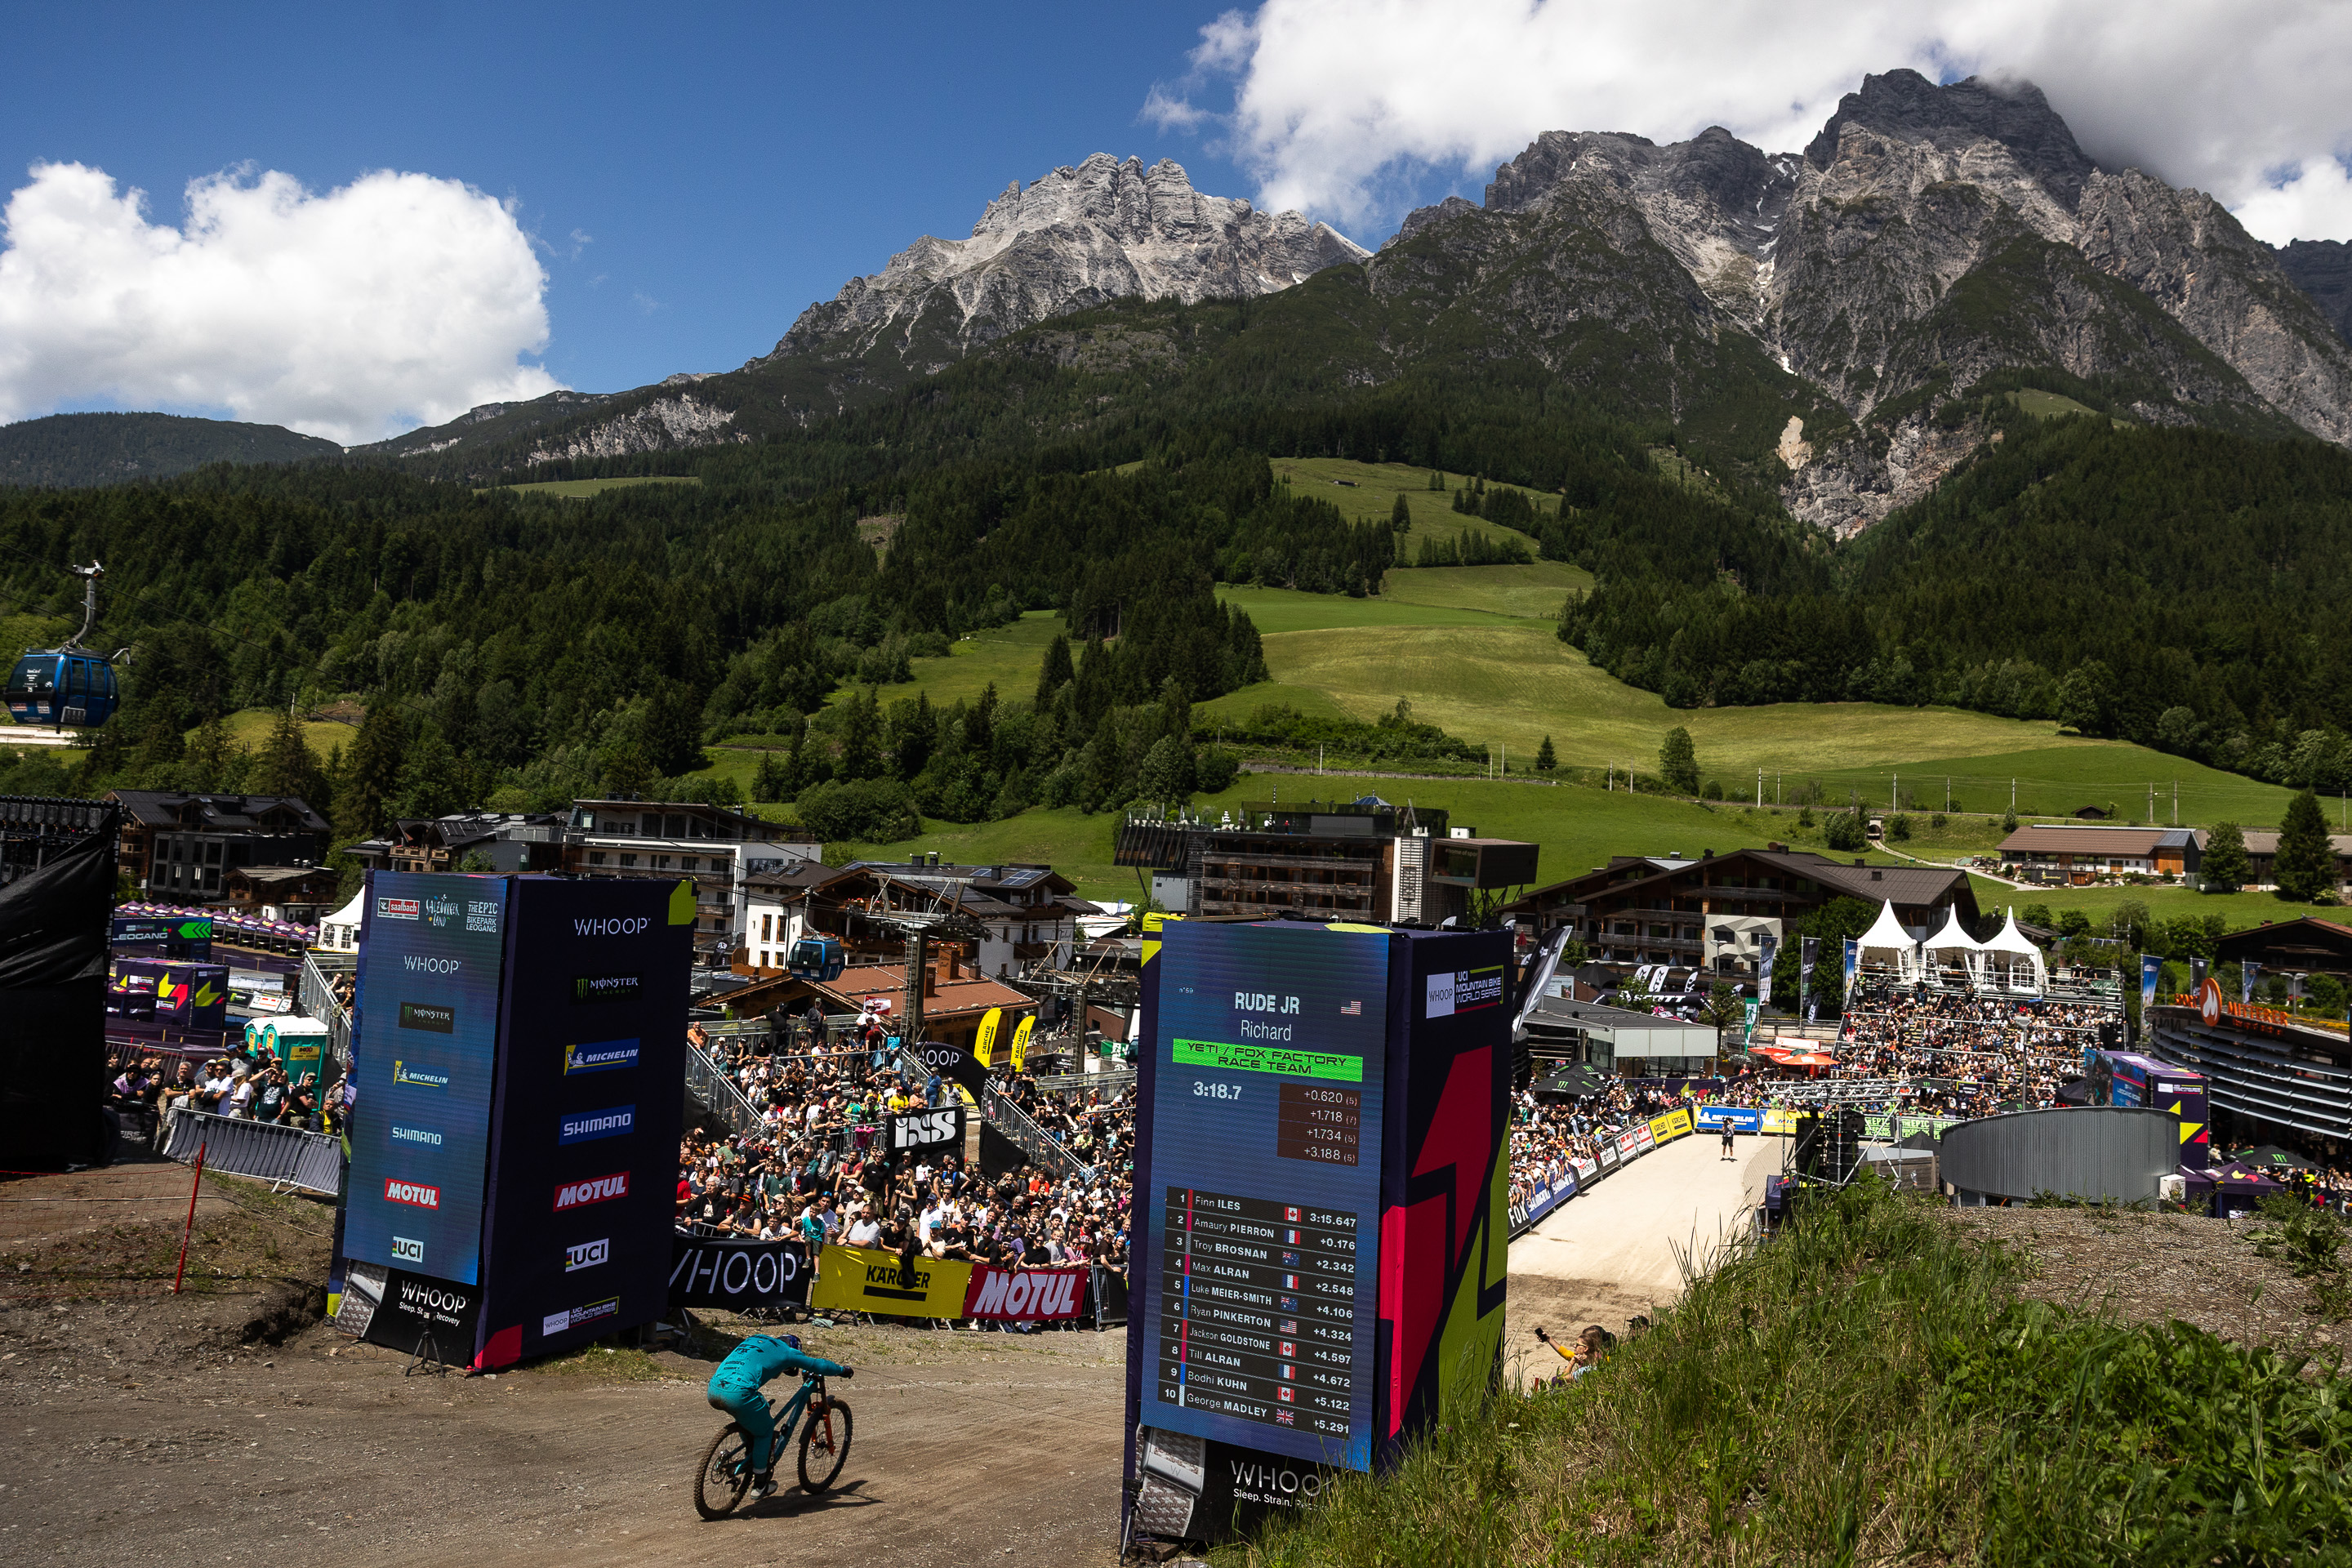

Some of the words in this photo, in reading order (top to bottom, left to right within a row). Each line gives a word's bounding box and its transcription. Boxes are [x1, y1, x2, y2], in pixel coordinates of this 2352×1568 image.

[390, 900, 417, 912] saalbach
[468, 904, 478, 913] THE
[479, 902, 498, 915] EPIC
[466, 924, 497, 933] LEOGANG
[467, 916, 497, 925] BIKEPARK
[574, 918, 648, 936] WHOOP
[403, 956, 459, 973] WHOOP
[590, 977, 639, 990] MONSTER
[1456, 978, 1488, 993] MOUNTAIN
[1488, 977, 1501, 987] BIKE
[1459, 970, 1468, 982] UCI
[1235, 991, 1276, 1013] RUDE
[1281, 996, 1299, 1014] JR
[1429, 988, 1453, 1002] WHOOP
[1456, 991, 1480, 1003] WORLD
[1481, 987, 1501, 999] SERIES
[413, 1008, 450, 1020] MONSTER
[2228, 1001, 2288, 1026] MITTERER
[1241, 1019, 1292, 1040] Richard
[586, 1049, 639, 1062] MICHELIN
[1187, 1042, 1218, 1054] YETI
[1235, 1047, 1266, 1058] FOX
[1272, 1052, 1348, 1067] FACTORY
[1218, 1057, 1260, 1069] RACE
[1266, 1062, 1312, 1074] TEAM
[408, 1073, 448, 1084] MICHELIN
[1193, 1081, 1242, 1099] 3:18.7
[1304, 1089, 1343, 1102] +0.620
[564, 1113, 631, 1136] SHIMANO
[1310, 1110, 1343, 1122] +1.718
[392, 1127, 442, 1145] SHIMANO
[1307, 1129, 1341, 1141] +1.734
[1304, 1147, 1340, 1160] +3.188
[387, 1183, 437, 1206] MOTUL
[557, 1176, 626, 1207] MOTUL
[1180, 1194, 1184, 1202] 1
[1195, 1196, 1214, 1207] Finn
[1218, 1199, 1241, 1210] ILES
[1310, 1214, 1356, 1227] 3:15.647
[1508, 1200, 1529, 1227] FOX
[1178, 1216, 1183, 1224] 2
[1194, 1218, 1227, 1233] Amaury
[1230, 1223, 1274, 1238] PIERRON
[1321, 1238, 1356, 1250] +0.176
[398, 1241, 421, 1258] UCI
[573, 1243, 606, 1265] UCI
[1176, 1237, 1183, 1245] 3
[1194, 1240, 1212, 1253] Troy
[1215, 1243, 1267, 1259] BROSNAN
[1316, 1259, 1354, 1273] +2.342
[866, 1265, 931, 1289] KÄRCER
[1175, 1259, 1181, 1267] 4
[1192, 1262, 1211, 1272] Max
[1214, 1266, 1250, 1279] ALRAN
[1316, 1282, 1354, 1296] +2.548
[402, 1281, 466, 1313] WHOOP
[973, 1272, 1076, 1315] MOTUL
[1192, 1283, 1209, 1294] Luke
[1212, 1287, 1272, 1306] MEIER-SMITH
[1316, 1306, 1352, 1319] +4.106
[399, 1302, 416, 1313] Sleep.
[570, 1306, 602, 1319] MOUNTAIN
[545, 1317, 568, 1329] WHOOP
[570, 1313, 593, 1324] WORLD
[1191, 1305, 1211, 1318] Ryan
[1214, 1310, 1271, 1327] PINKERTON
[1314, 1328, 1352, 1342] +4.324
[1190, 1328, 1218, 1340] Jackson
[1220, 1334, 1271, 1349] GOLDSTONE
[1315, 1351, 1351, 1364] +4.597
[1188, 1349, 1202, 1360] Till
[1205, 1353, 1241, 1367] ALRAN
[1313, 1374, 1350, 1388] +4.672
[1171, 1368, 1177, 1376] 9
[1188, 1371, 1214, 1384] Bodhi
[1218, 1378, 1247, 1391] KUHN
[1315, 1397, 1349, 1410] +5.122
[1165, 1389, 1176, 1398] 10
[1187, 1393, 1221, 1409] George
[1224, 1401, 1267, 1418] MADLEY
[1233, 1488, 1261, 1502] Sleep.
[1264, 1494, 1292, 1507] Strain.
